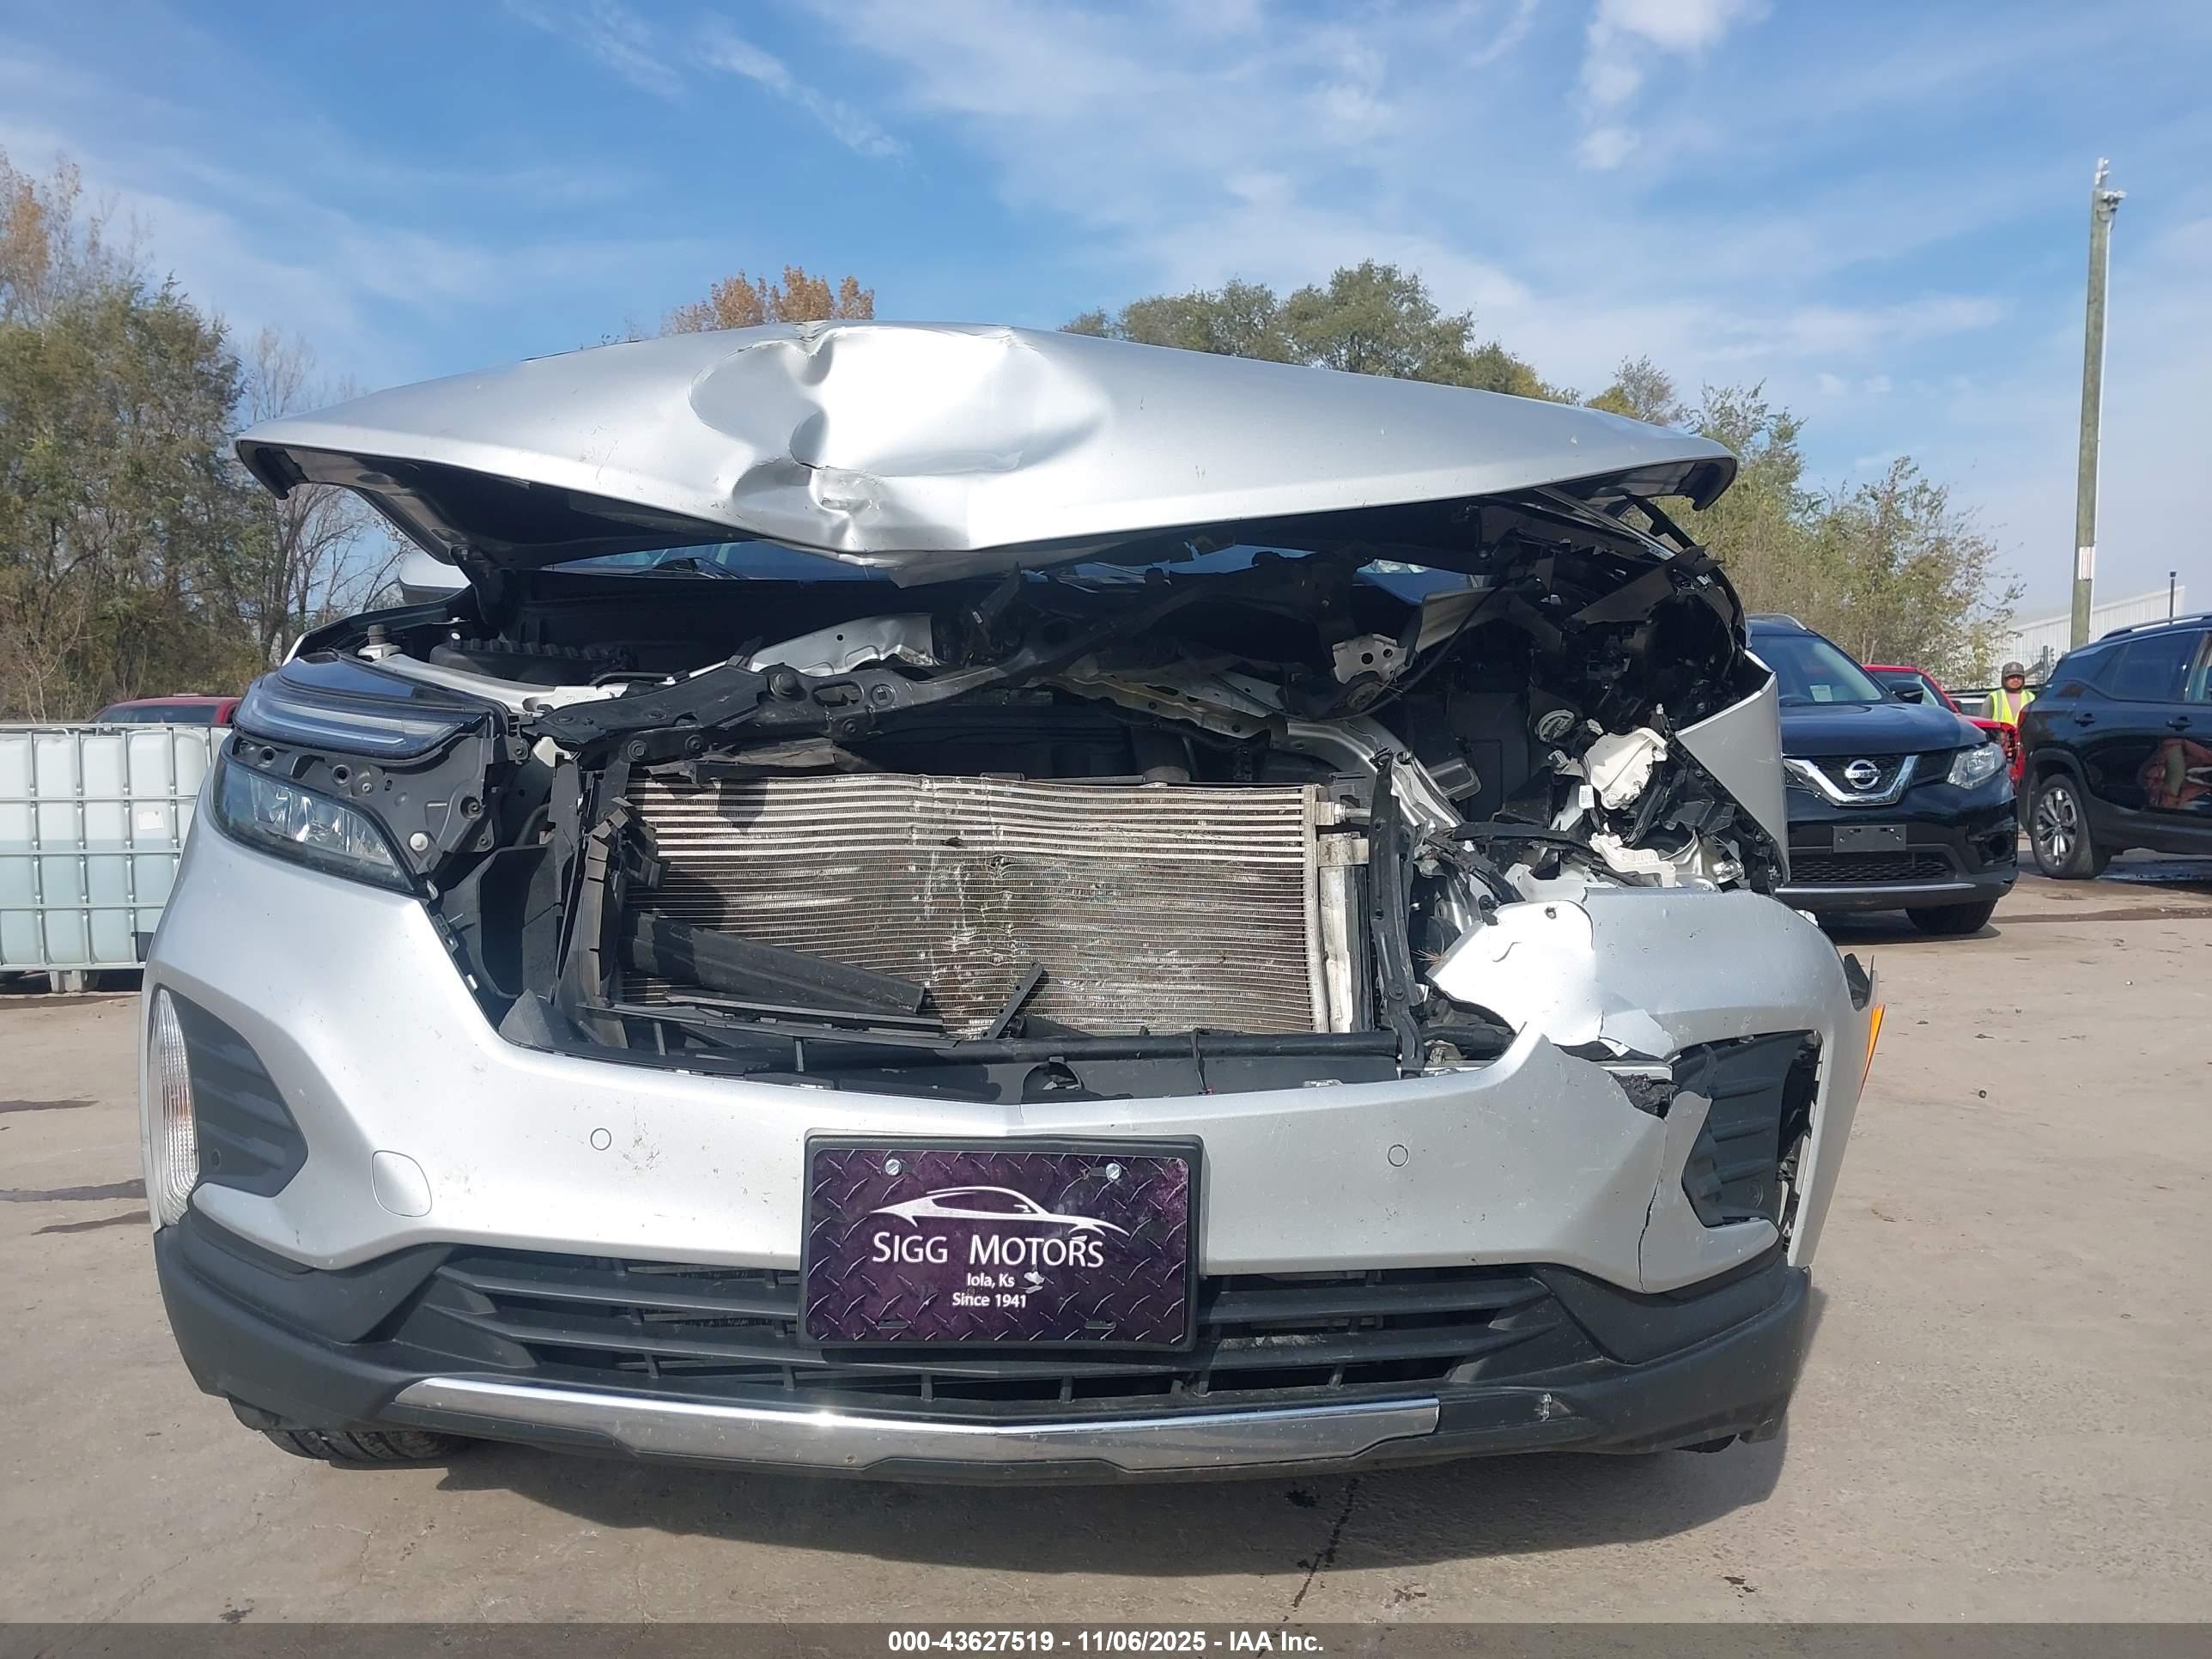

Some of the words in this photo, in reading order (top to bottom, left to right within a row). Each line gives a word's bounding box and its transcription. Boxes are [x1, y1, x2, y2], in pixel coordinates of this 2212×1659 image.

[872, 1231, 948, 1263] SIGG
[969, 1234, 1104, 1268] MOTORS
[967, 1272, 996, 1289] Iola,
[999, 1273, 1015, 1288] Ks
[952, 1291, 990, 1307] Since
[995, 1293, 1026, 1308] 1941
